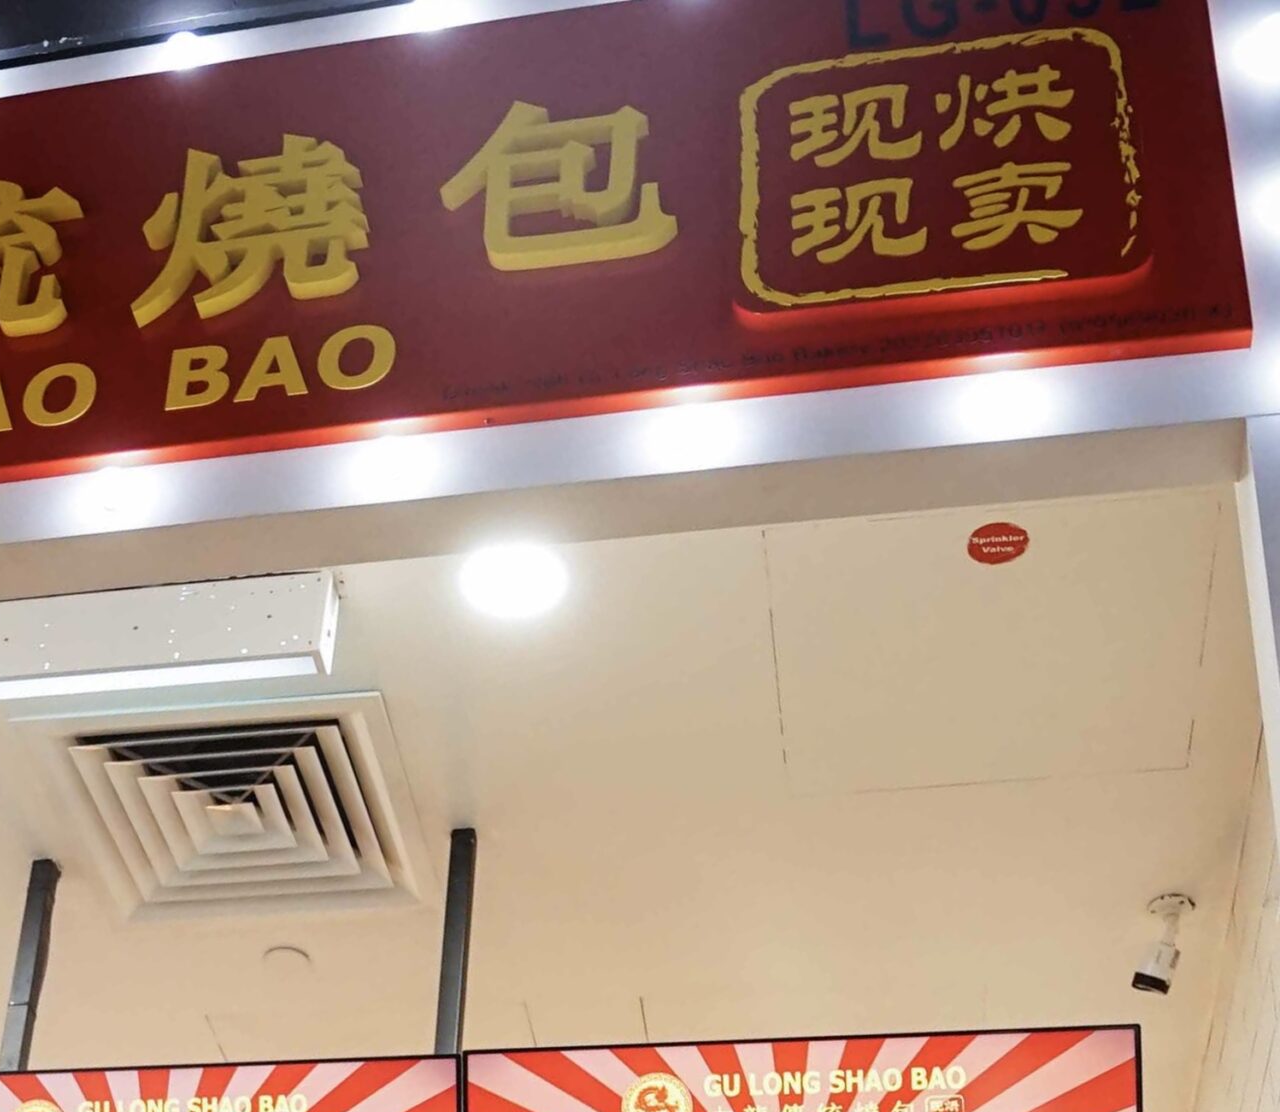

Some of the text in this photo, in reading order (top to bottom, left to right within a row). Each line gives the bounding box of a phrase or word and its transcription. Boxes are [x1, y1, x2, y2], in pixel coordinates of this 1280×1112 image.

[788, 64, 1075, 169] 现烘
[790, 160, 1083, 266] 现卖
[164, 324, 397, 411] BAO
[971, 535, 1024, 545] Sprinkler
[703, 1066, 967, 1098] GU LONG SHAO BAO
